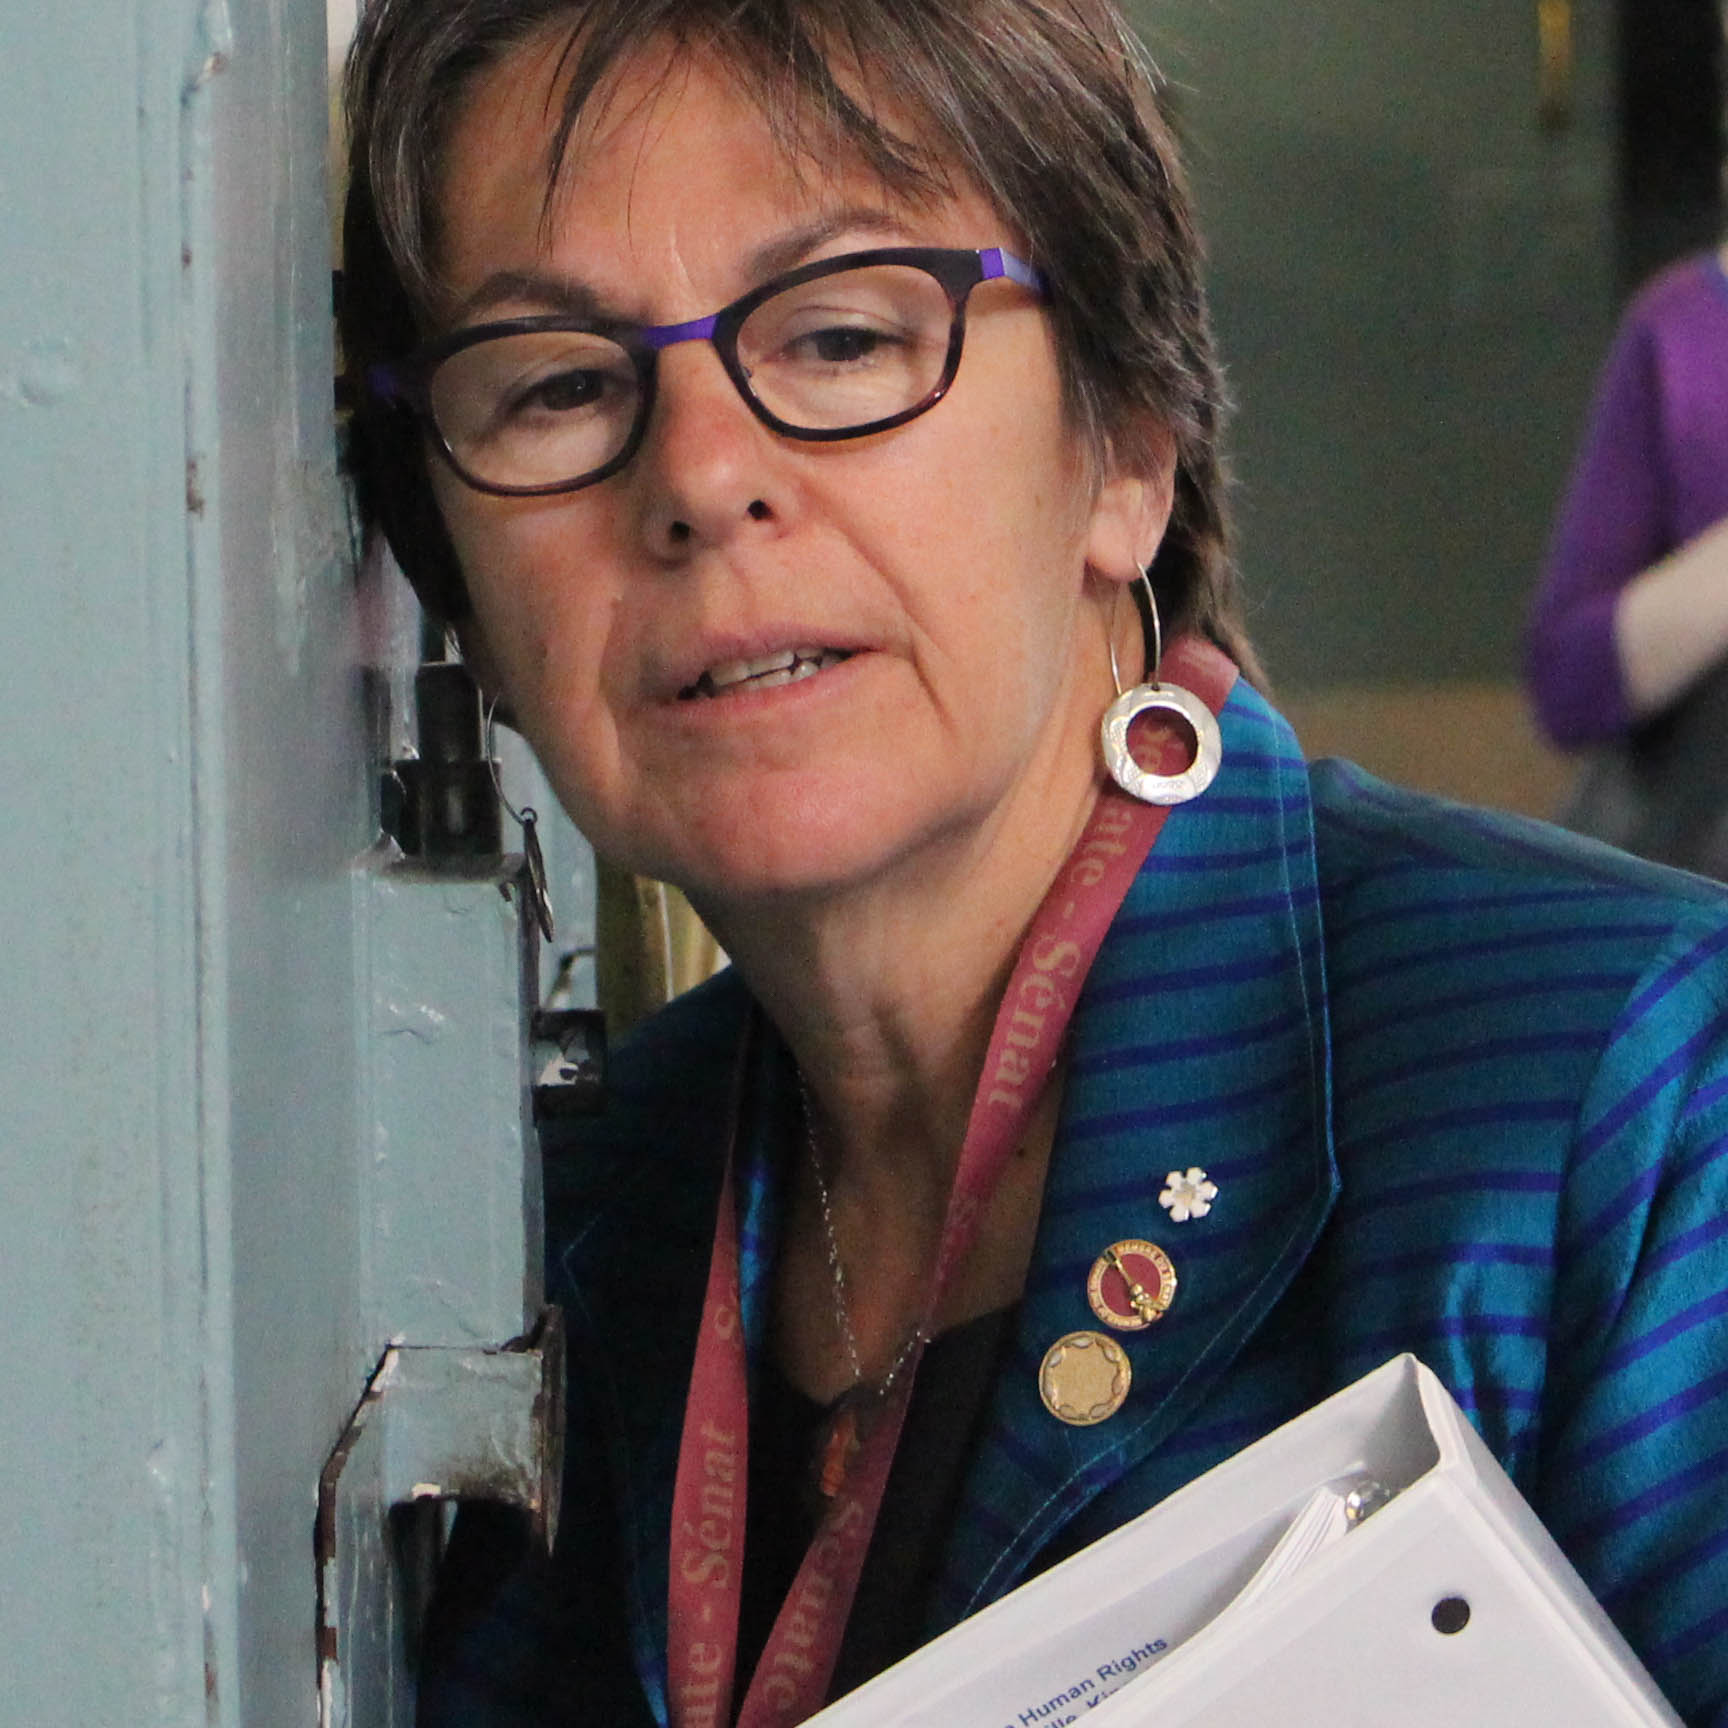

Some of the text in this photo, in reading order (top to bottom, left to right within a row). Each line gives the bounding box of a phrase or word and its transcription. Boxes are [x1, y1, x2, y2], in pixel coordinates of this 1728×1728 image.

[986, 934, 1081, 1109] Sénat
[680, 1420, 737, 1590] Sénat
[1018, 1678, 1095, 1727] Human
[1095, 1637, 1169, 1683] Rights
